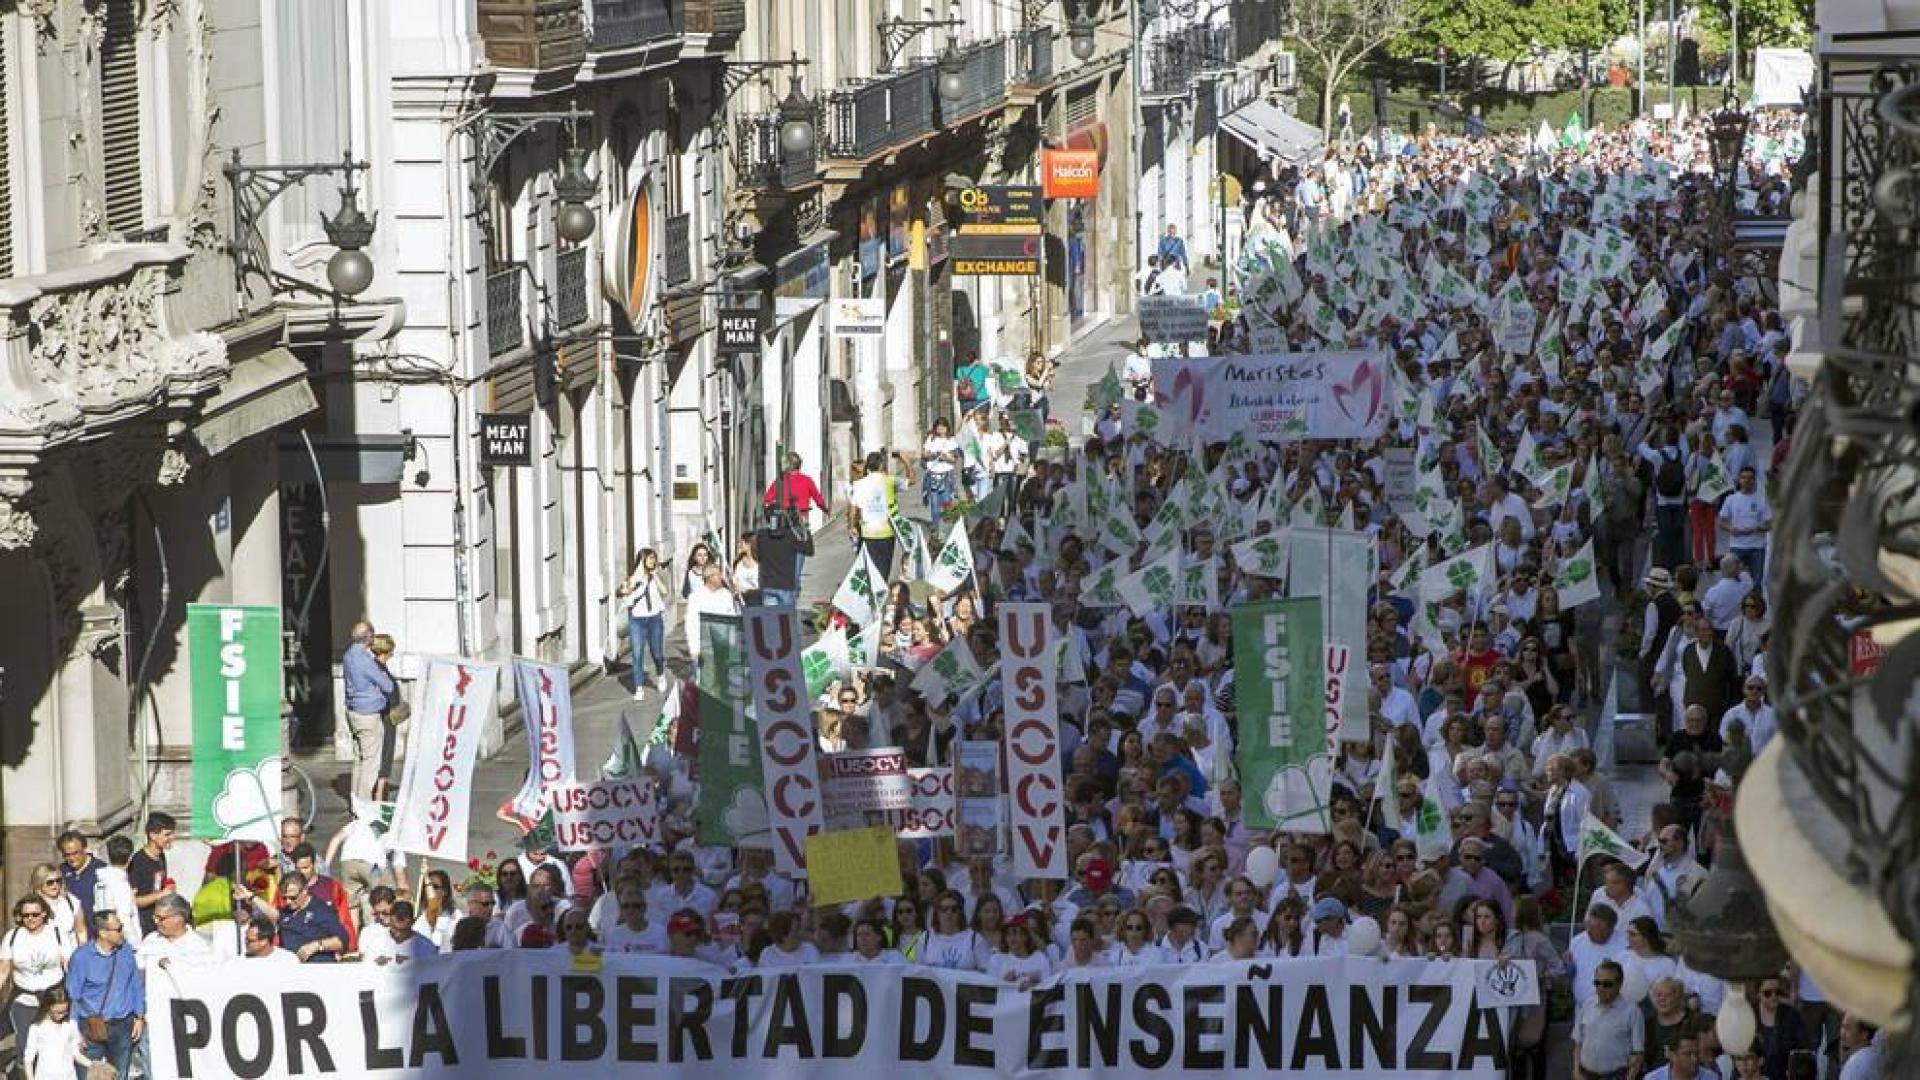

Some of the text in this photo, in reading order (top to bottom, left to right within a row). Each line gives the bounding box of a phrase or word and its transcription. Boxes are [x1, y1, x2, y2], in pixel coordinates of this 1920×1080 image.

[1053, 162, 1092, 178] Halcón
[955, 260, 1037, 273] EXCHANGE
[723, 318, 757, 331] MEAT
[726, 331, 755, 344] MAN
[487, 424, 529, 439] MEAT
[490, 440, 525, 456] MAN
[220, 609, 247, 751] FSIE
[1264, 613, 1293, 748] FSIE
[1007, 611, 1060, 869] USOCV
[427, 704, 466, 850] USOCV
[840, 754, 902, 775] USOCV
[552, 781, 650, 813] USOCV
[557, 815, 658, 847] USOCV
[170, 963, 1506, 1079] POR LA LIBERTAD DE ENSEÑANZA
